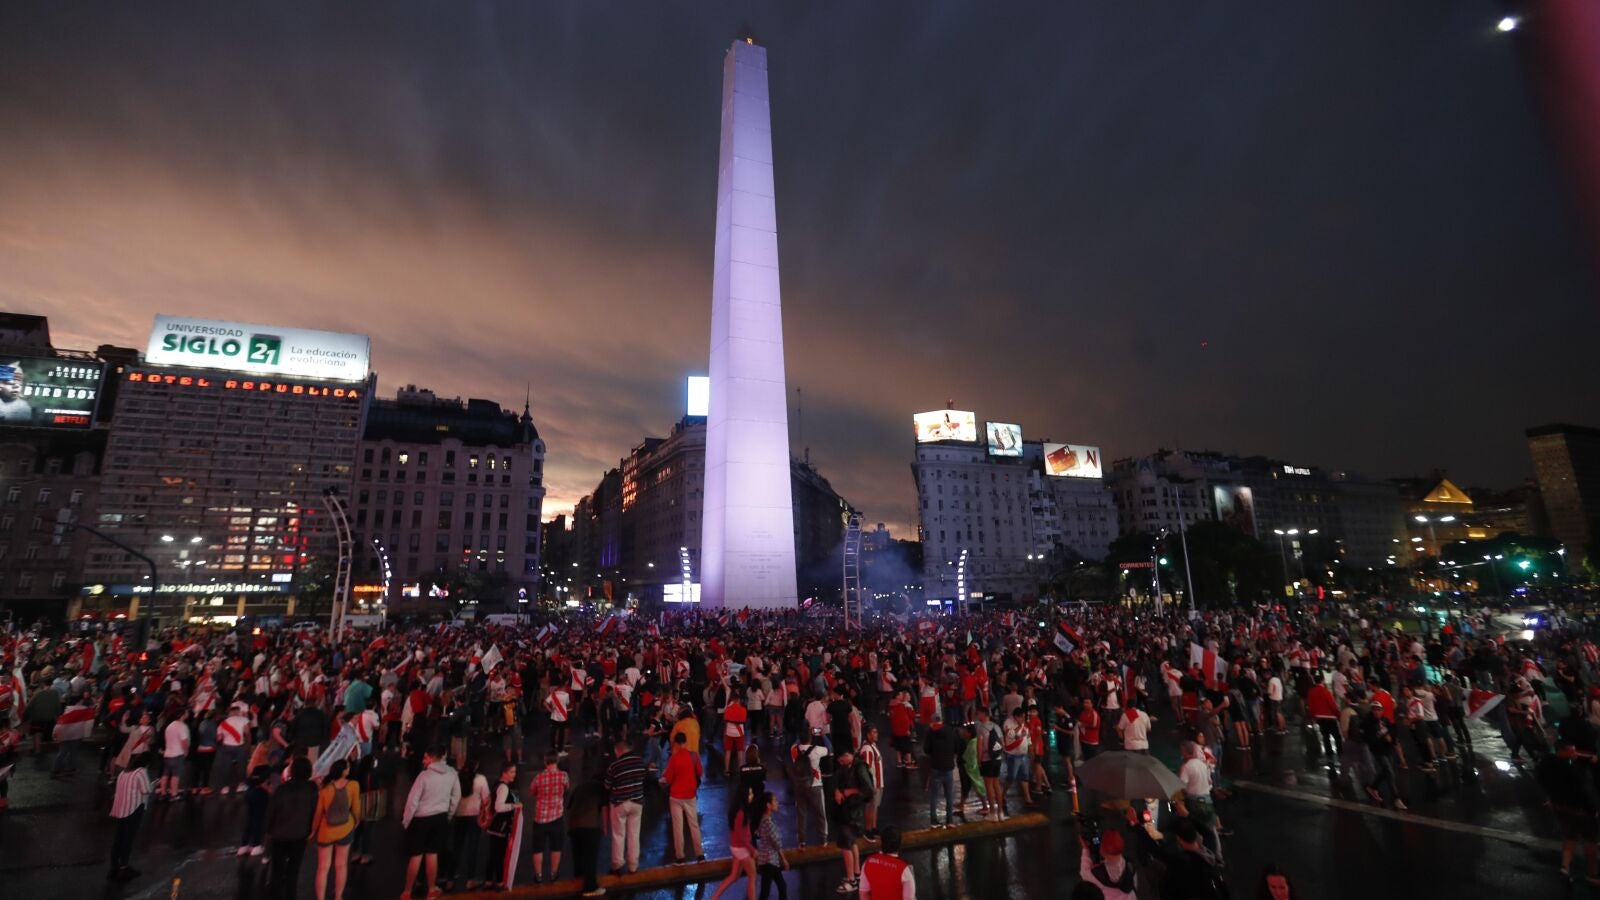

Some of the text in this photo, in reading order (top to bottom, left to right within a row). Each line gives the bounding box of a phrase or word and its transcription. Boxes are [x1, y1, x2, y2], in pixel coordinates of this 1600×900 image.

[166, 323, 243, 337] UNIVERSIDAD
[162, 333, 276, 365] SIGLO 21
[291, 346, 357, 360] La educación
[290, 355, 346, 367] evoluciona
[129, 373, 357, 398] HOTEL REPUBLICA
[23, 386, 62, 398] BIRD
[67, 388, 96, 400] BOX
